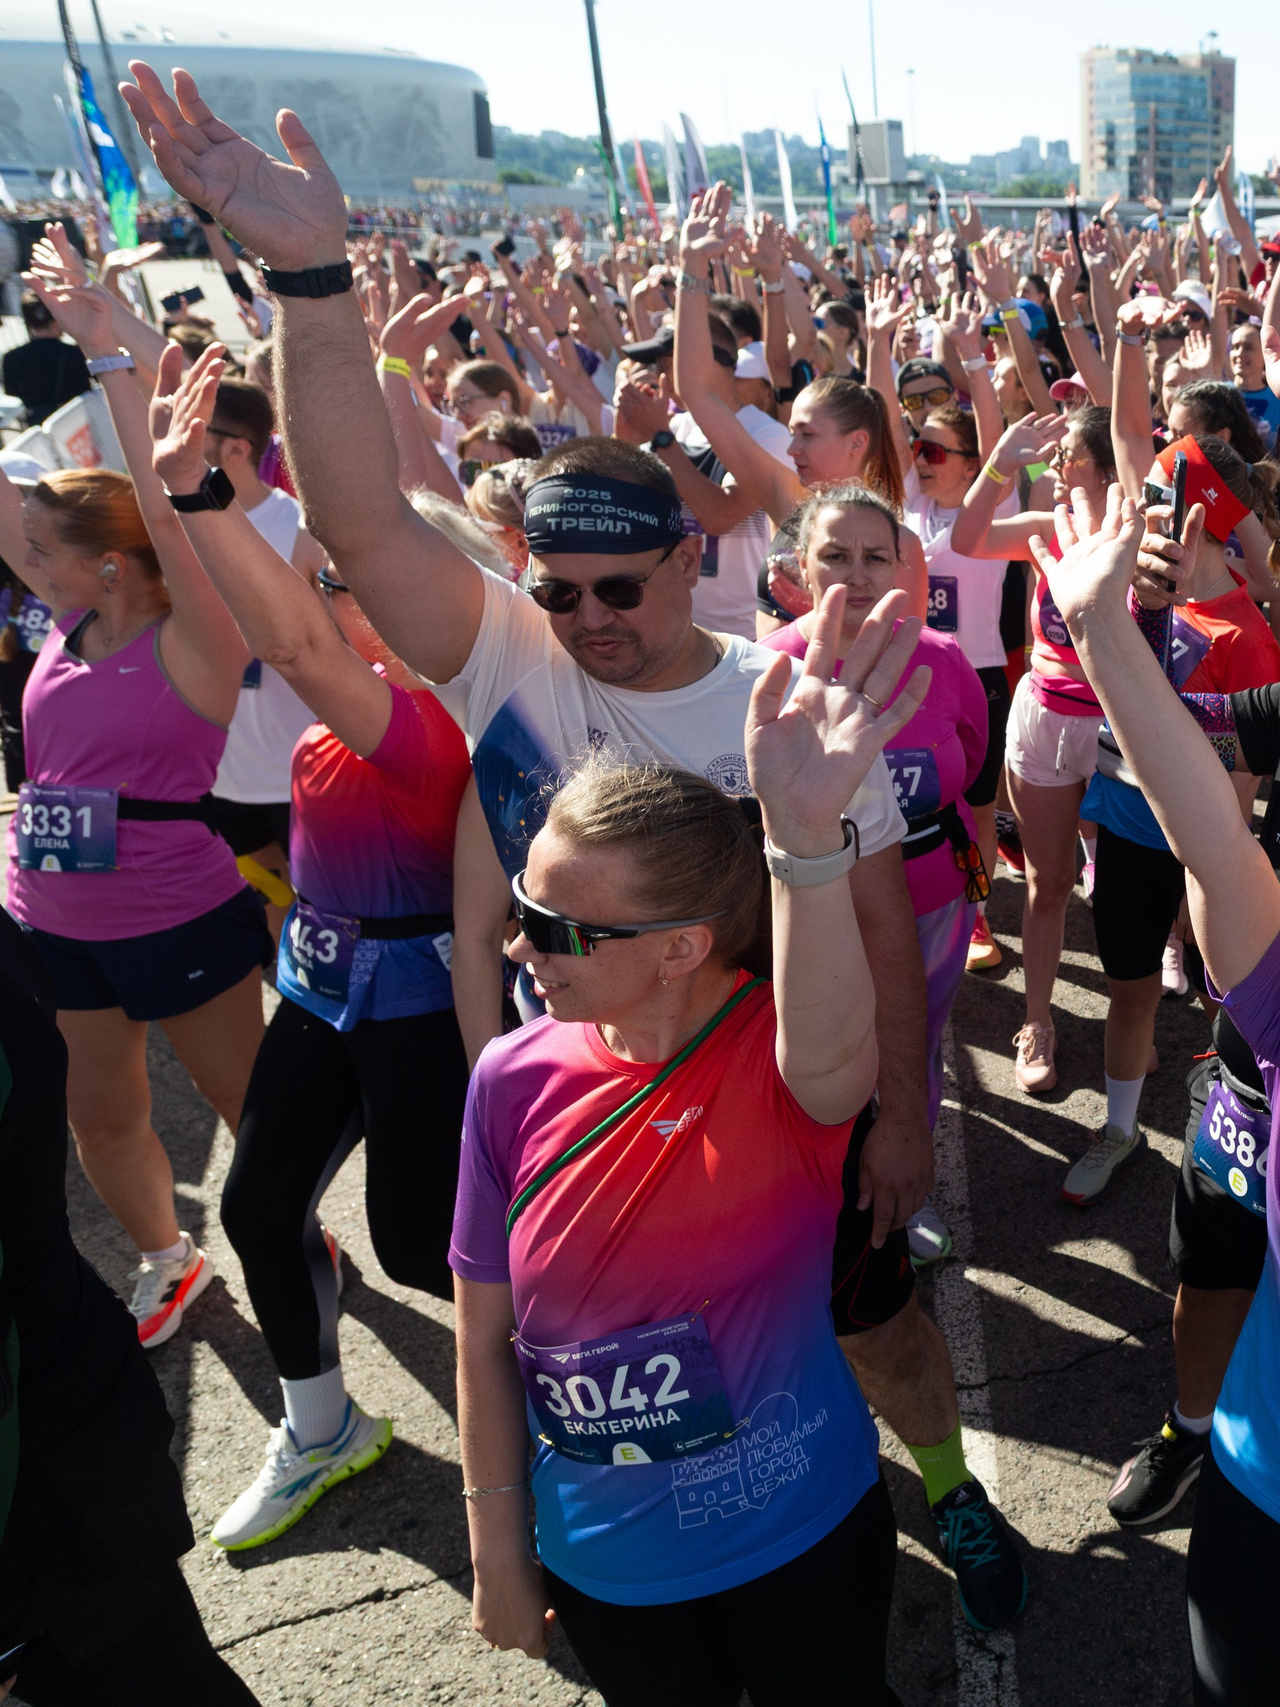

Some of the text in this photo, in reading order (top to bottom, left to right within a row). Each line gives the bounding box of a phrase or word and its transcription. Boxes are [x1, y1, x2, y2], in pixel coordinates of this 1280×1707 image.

[563, 488, 612, 501] 2025
[529, 502, 659, 528] ЛЕНИНОГОРСКИЙ
[547, 515, 632, 535] ТРЕЙЛ
[21, 803, 92, 838] 3331
[34, 837, 70, 850] ЕЛЕНА
[536, 1353, 691, 1419] 3042
[563, 1407, 682, 1436] ЕКАТЕРИНА
[741, 1420, 781, 1450] МОЙ
[746, 1407, 829, 1467] ЛЮБИМЫЙ
[749, 1444, 806, 1483] ГОРОД
[752, 1456, 812, 1499] БЕЖИТ
